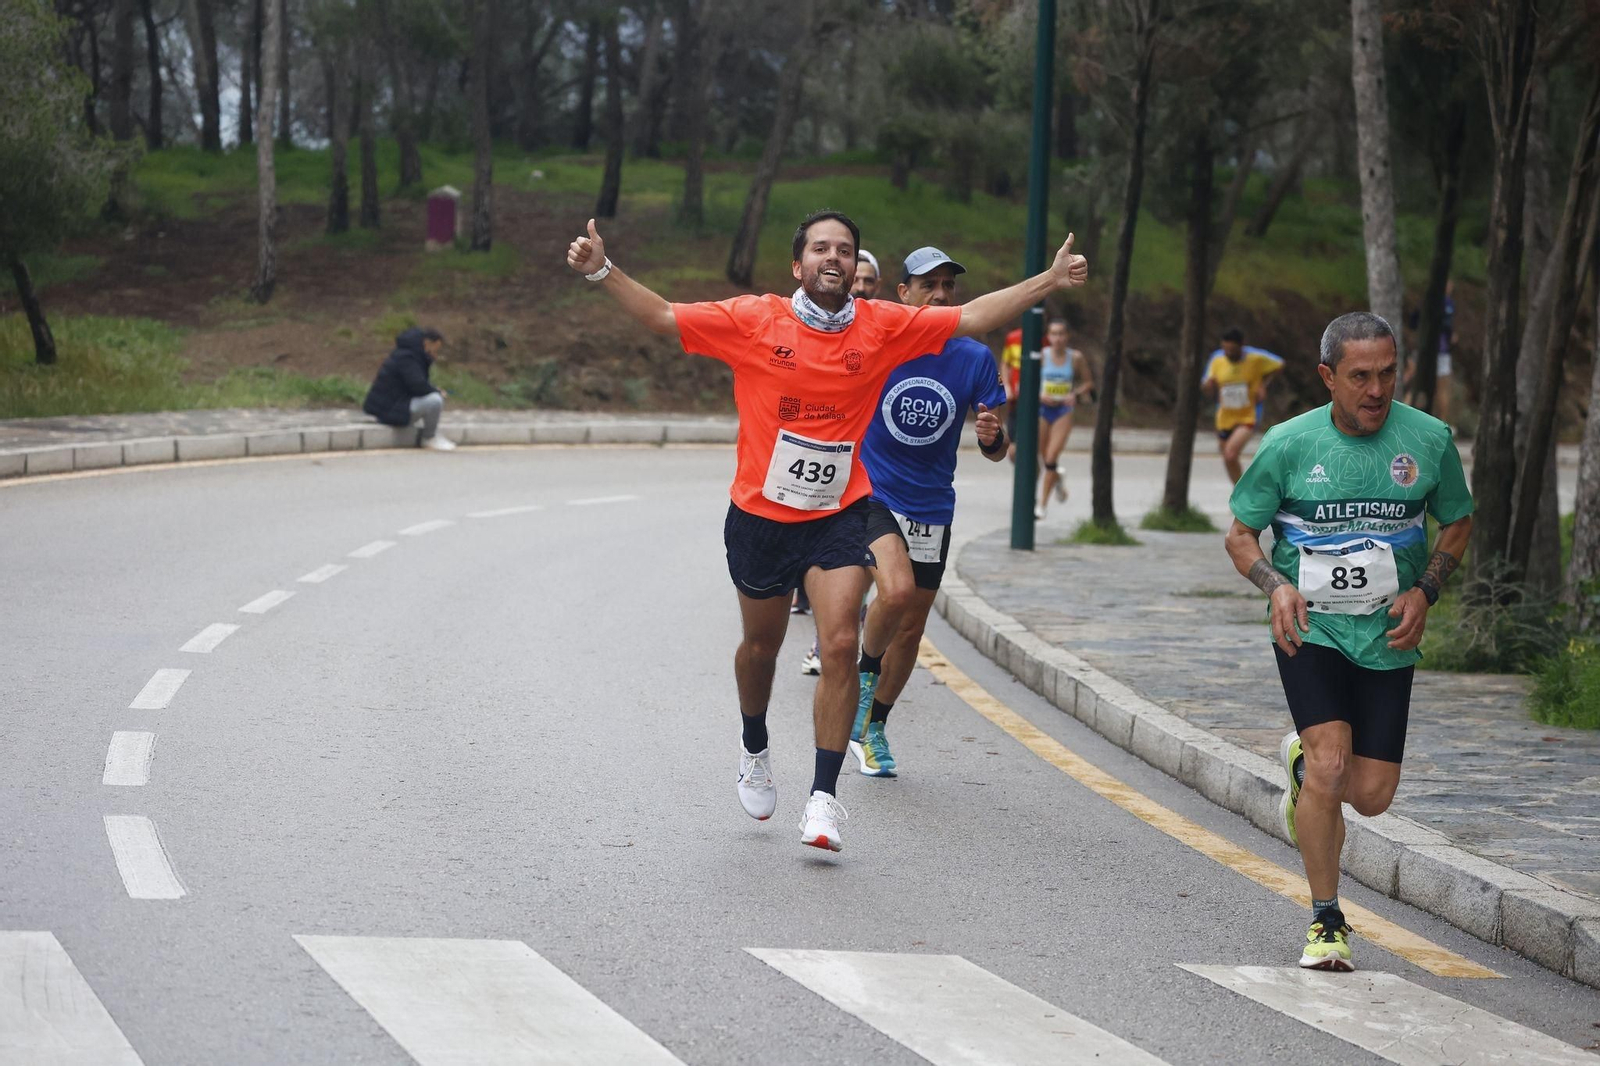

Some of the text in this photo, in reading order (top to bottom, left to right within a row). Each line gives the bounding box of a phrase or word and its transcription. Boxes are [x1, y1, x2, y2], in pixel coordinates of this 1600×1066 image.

[769, 357, 797, 368] HYUNDAI
[892, 379, 935, 394] CAMPEONATOS
[936, 385, 943, 393] DE
[943, 392, 956, 414] ESPAÑA
[805, 404, 836, 412] Ciudad
[900, 396, 942, 416] RCM
[816, 412, 846, 421] Málaga
[898, 410, 940, 428] 1873
[894, 431, 936, 444] COPA STADIUM
[788, 458, 837, 485] 439
[1314, 502, 1406, 520] ATLETISMO
[1330, 566, 1369, 590] 83
